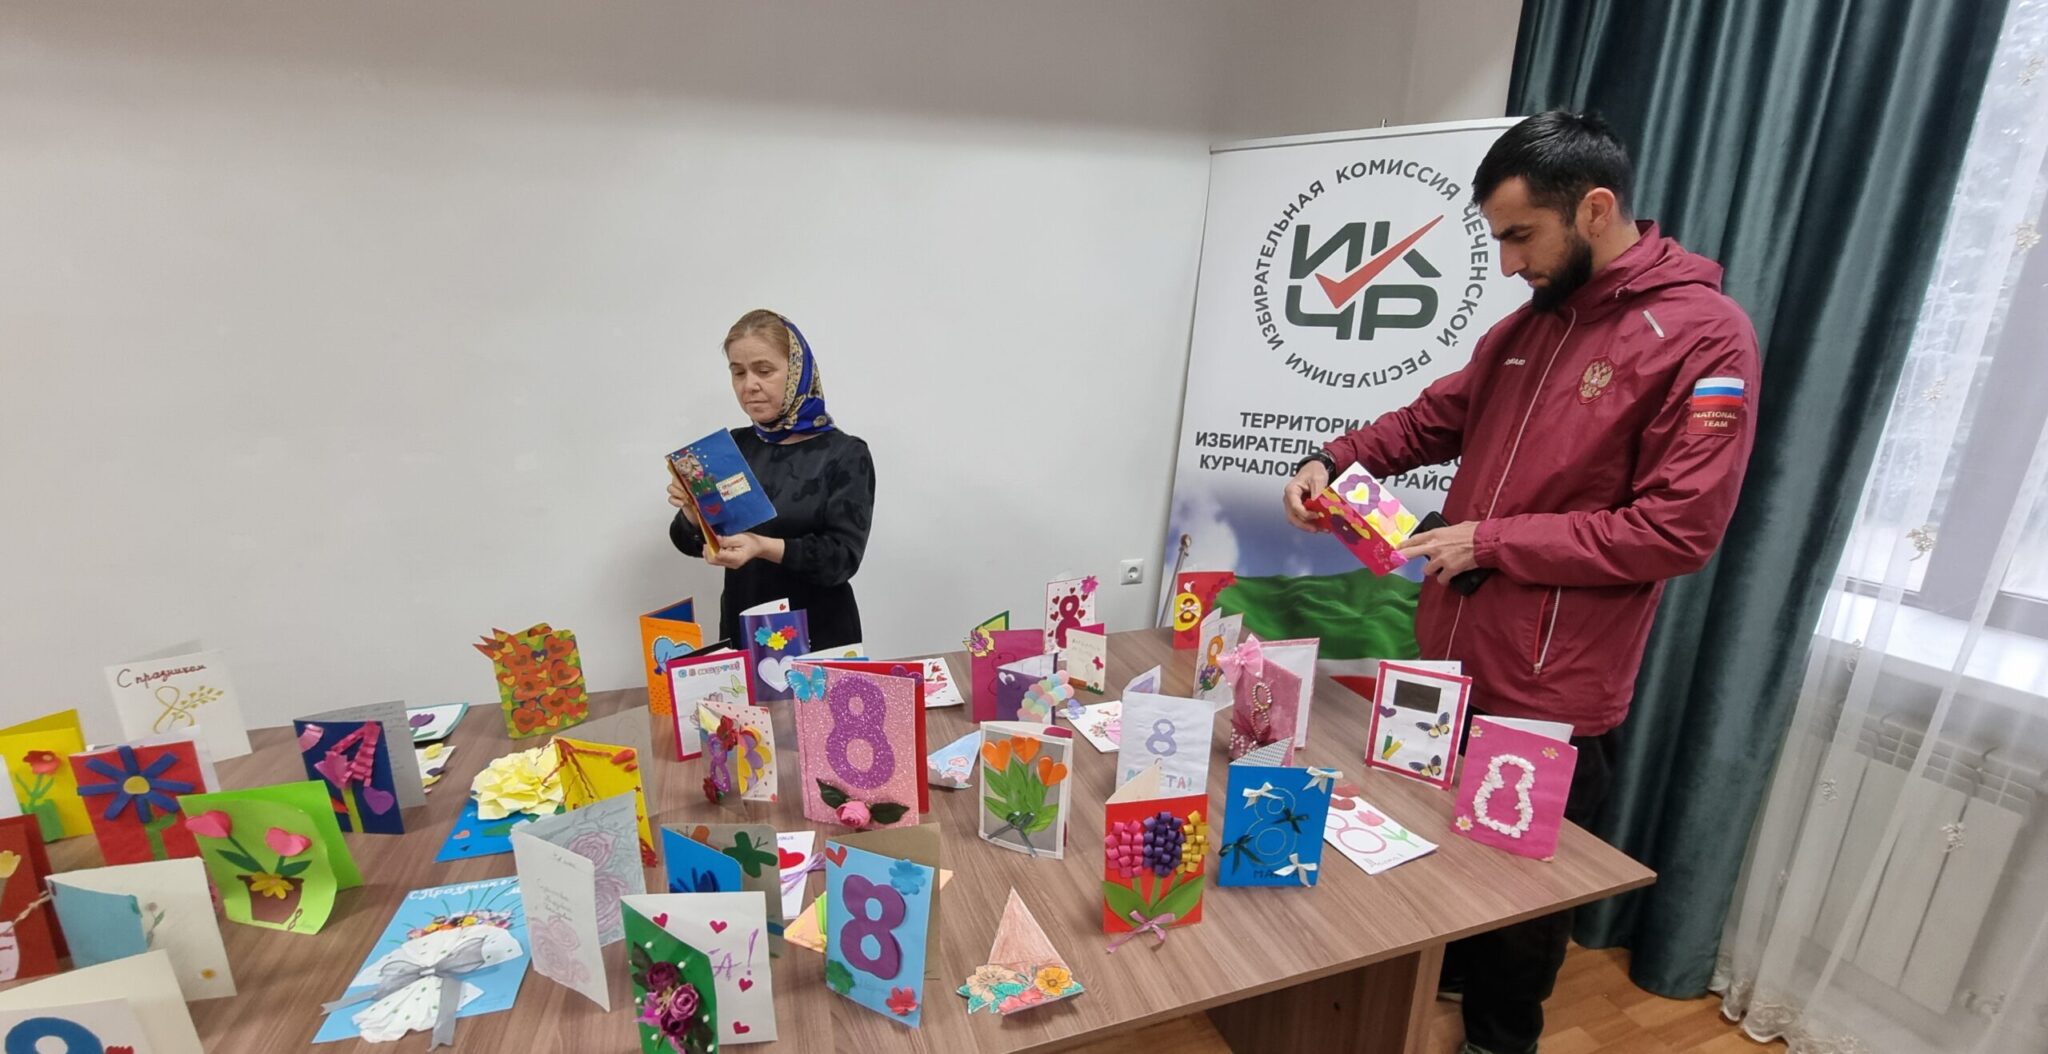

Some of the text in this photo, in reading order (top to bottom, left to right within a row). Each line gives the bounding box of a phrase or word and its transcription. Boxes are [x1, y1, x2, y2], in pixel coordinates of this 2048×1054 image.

[1335, 158, 1461, 201] КОМИССИЯ
[1253, 180, 1325, 351] ИЗБИРАТЕЛЬНАЯ
[1436, 202, 1489, 348] ЧЕЧЕНСКОЙ
[1285, 349, 1433, 388] РЕСПУБЛИКИ
[1692, 411, 1738, 419] NATIONAL
[1703, 420, 1728, 428] TEAM
[1393, 470, 1454, 492] РАЙО
[826, 675, 895, 790] 8
[1145, 719, 1177, 757] 8
[840, 874, 906, 980] 8
